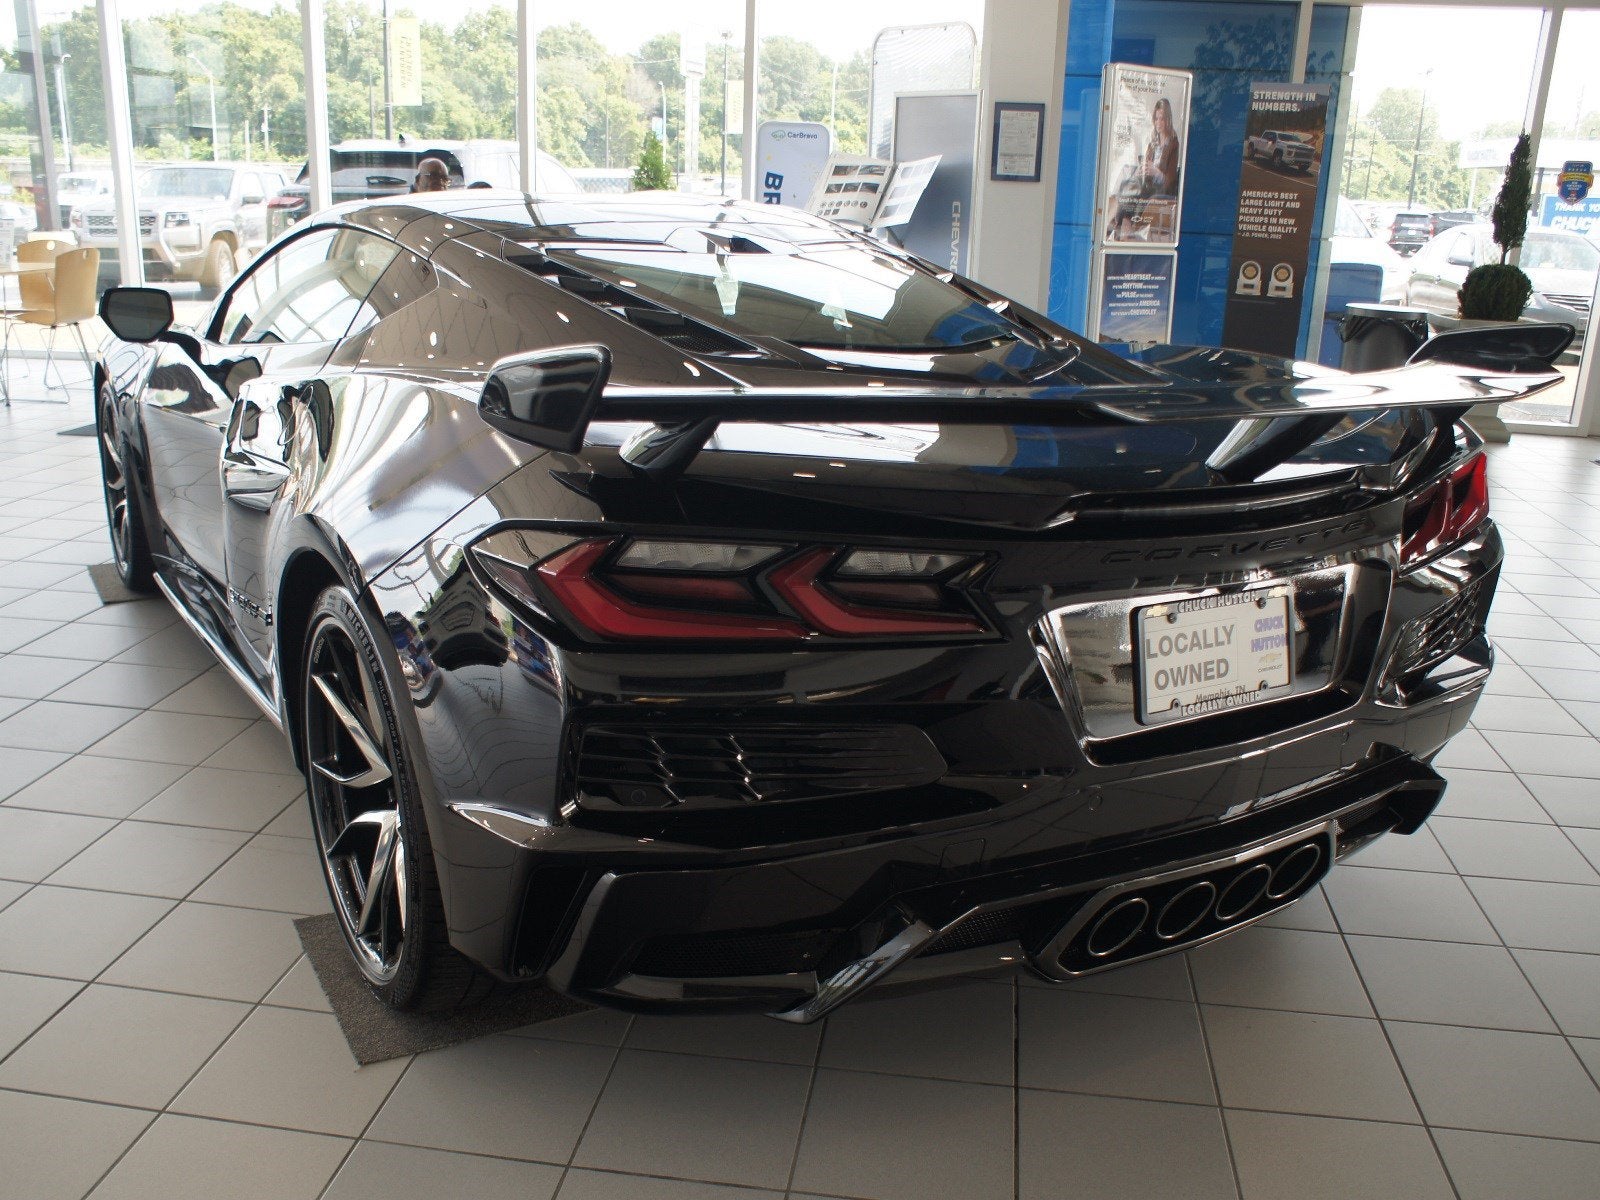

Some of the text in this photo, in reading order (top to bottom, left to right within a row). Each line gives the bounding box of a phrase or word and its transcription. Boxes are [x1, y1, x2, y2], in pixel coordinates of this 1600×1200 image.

[1253, 91, 1317, 102] STRENGTH IN
[1251, 101, 1300, 112] NUMBERS.
[787, 131, 818, 140] CarBravo
[1242, 190, 1299, 200] AMERICA'S BEST
[1240, 198, 1300, 209] LARGE LIGHT AND
[1240, 207, 1283, 216] HEAVY DUTY
[1239, 215, 1269, 224] PICKUPS
[1279, 218, 1296, 226] NEW
[1238, 223, 1298, 234] VEHICLE QUALITY
[1124, 273, 1152, 281] HEARTBEAT
[1122, 282, 1143, 290] RHYTHM
[1101, 515, 1375, 564] CORVETTE
[1177, 590, 1258, 614] CHUCK HUTTON
[1253, 615, 1284, 633] CHUCK
[346, 603, 381, 674] MICHELIN
[1145, 624, 1235, 660] LOCALLY
[1250, 634, 1287, 653] HUTTON
[1154, 658, 1230, 691] OWNED
[377, 680, 389, 707] PILOT
[1235, 684, 1246, 694] TN
[1181, 691, 1260, 717] LOCALLY OWNED
[386, 710, 398, 744] SPORT
